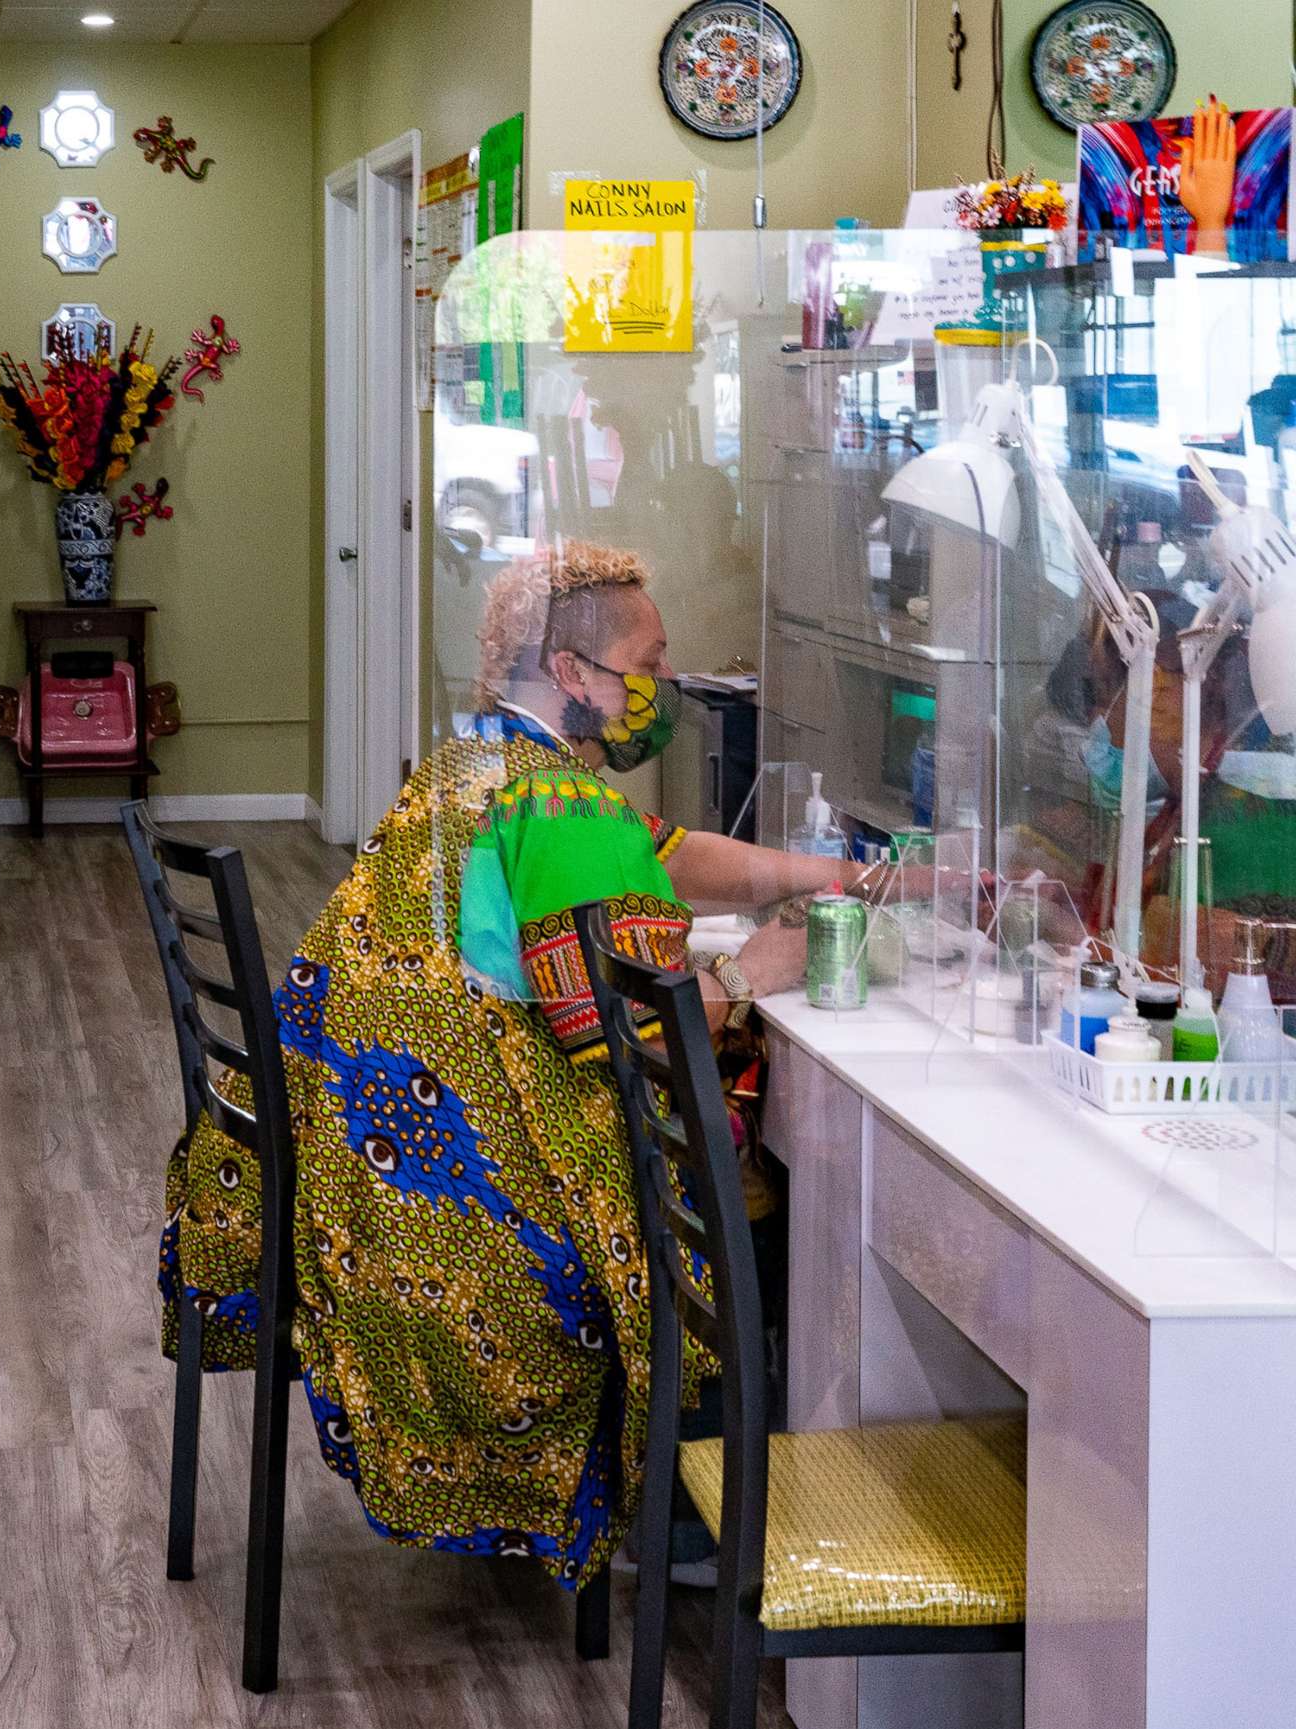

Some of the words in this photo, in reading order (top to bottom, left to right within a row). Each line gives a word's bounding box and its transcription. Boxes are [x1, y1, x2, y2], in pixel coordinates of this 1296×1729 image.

[586, 182, 651, 199] CONNY
[570, 199, 627, 217] NAILS
[633, 200, 686, 217] SALON
